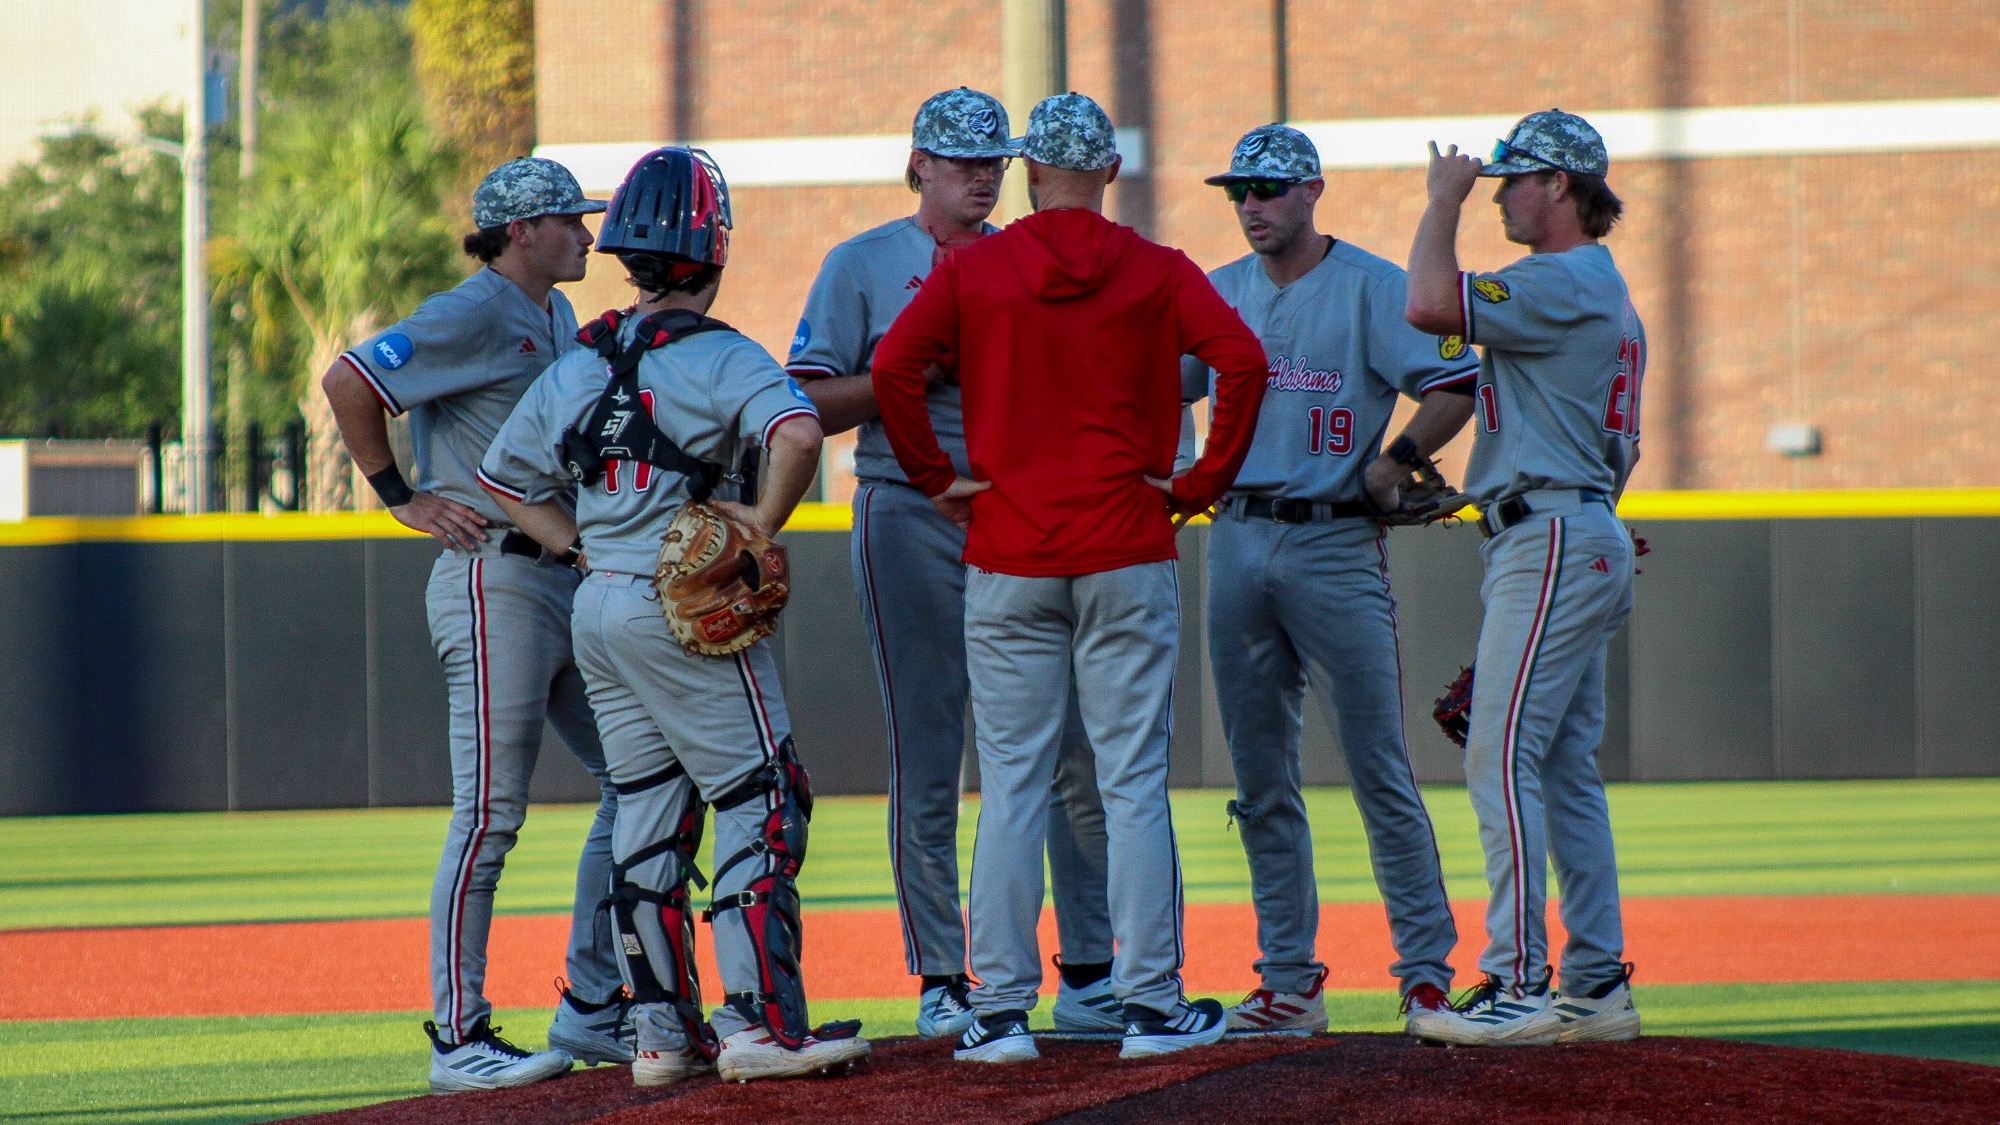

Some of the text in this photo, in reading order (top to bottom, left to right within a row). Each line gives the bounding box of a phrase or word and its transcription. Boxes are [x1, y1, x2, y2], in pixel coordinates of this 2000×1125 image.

[376, 341, 402, 368] NCAA
[1266, 354, 1342, 393] Alabama
[1602, 333, 1641, 438] 21
[1307, 405, 1356, 456] 19
